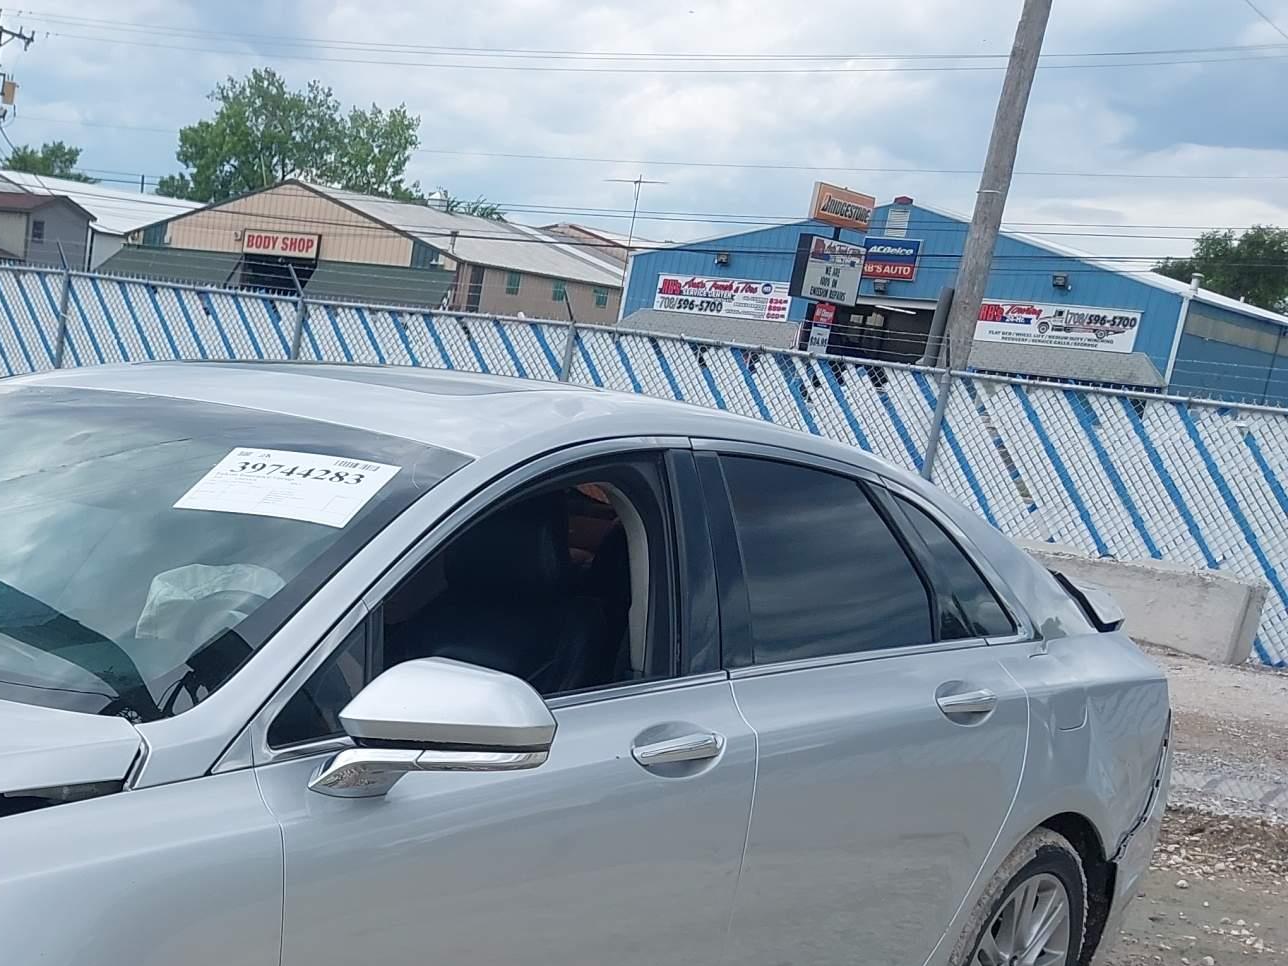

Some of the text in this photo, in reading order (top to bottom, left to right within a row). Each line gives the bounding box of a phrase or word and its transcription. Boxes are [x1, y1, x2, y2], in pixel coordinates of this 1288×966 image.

[821, 192, 871, 224] BRIDGESTONE
[247, 234, 315, 253] BODY SHOP
[868, 245, 914, 256] ACDelco
[883, 265, 911, 275] AUTO
[229, 461, 365, 484] 39744283
